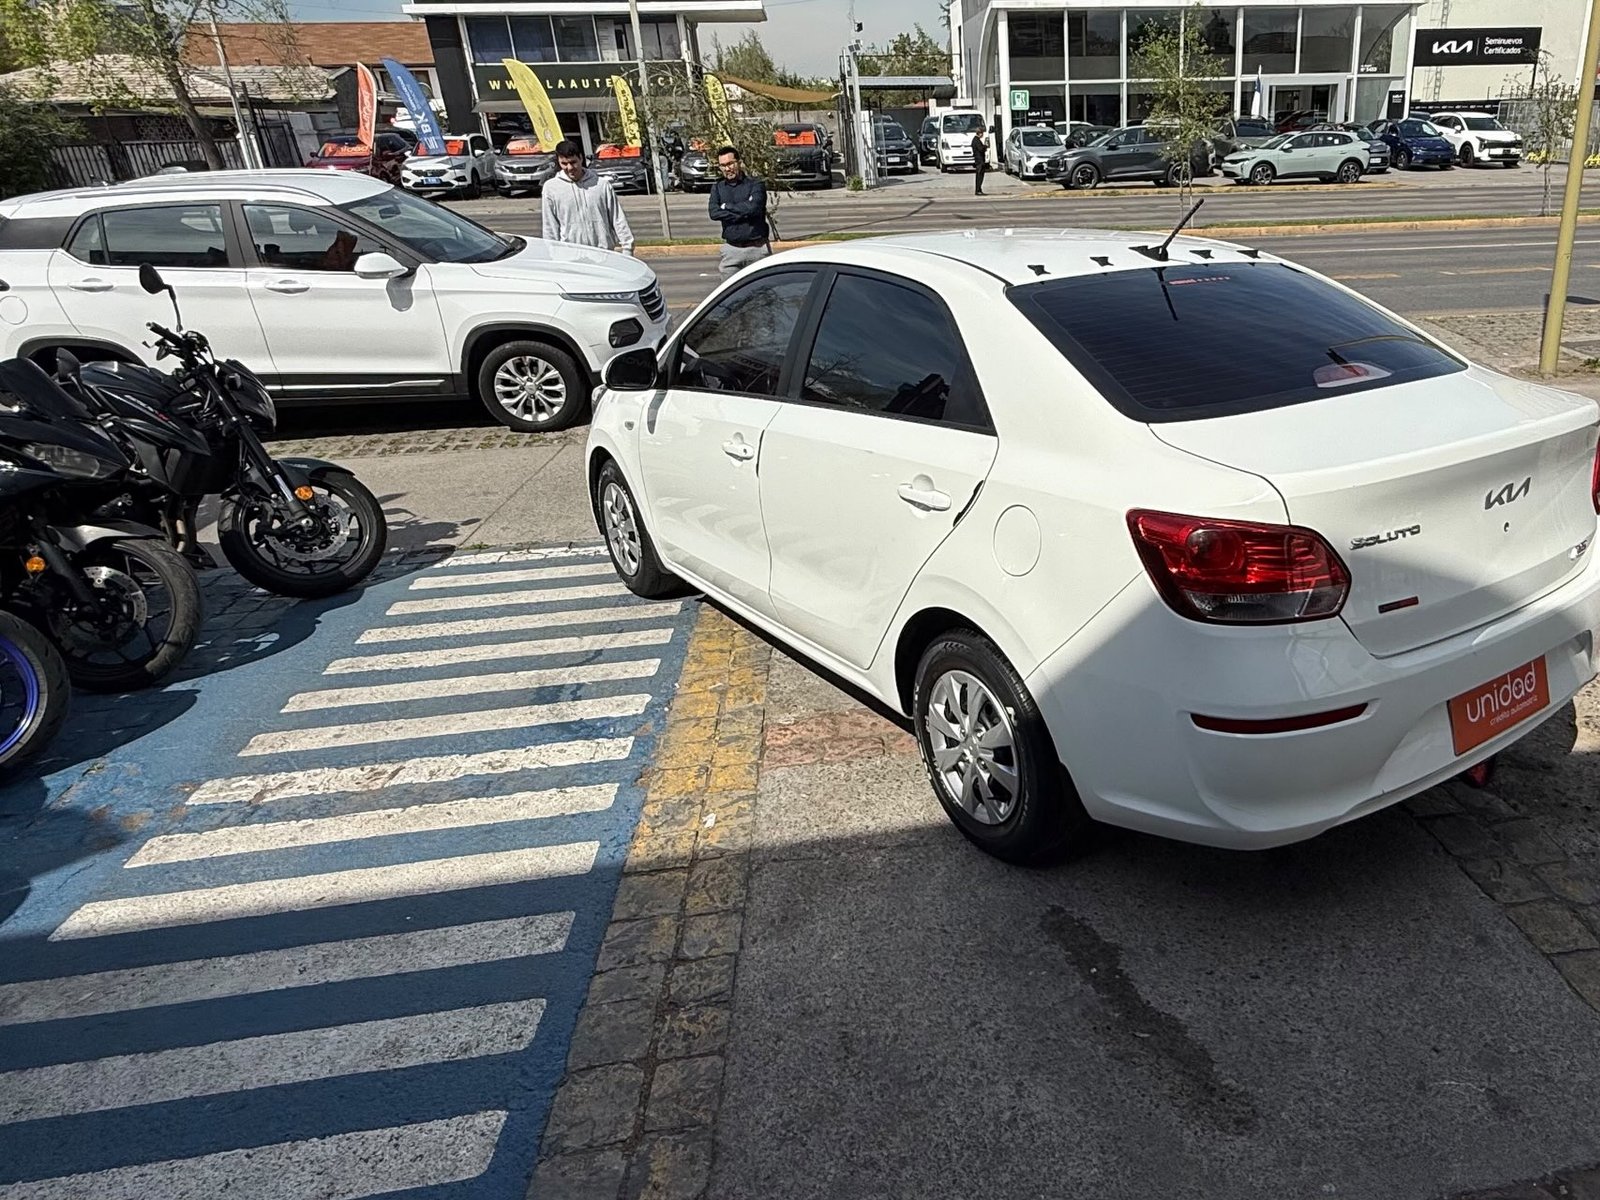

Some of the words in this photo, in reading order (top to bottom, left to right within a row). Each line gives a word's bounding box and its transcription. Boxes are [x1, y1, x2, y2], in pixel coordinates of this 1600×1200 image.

[1432, 40, 1474, 54] KIA
[1484, 46, 1522, 56] Certificados
[1485, 37, 1523, 46] Seminuevos
[1485, 477, 1532, 510] KIA
[1350, 525, 1421, 551] SOLUTO
[1466, 661, 1537, 723] unidad
